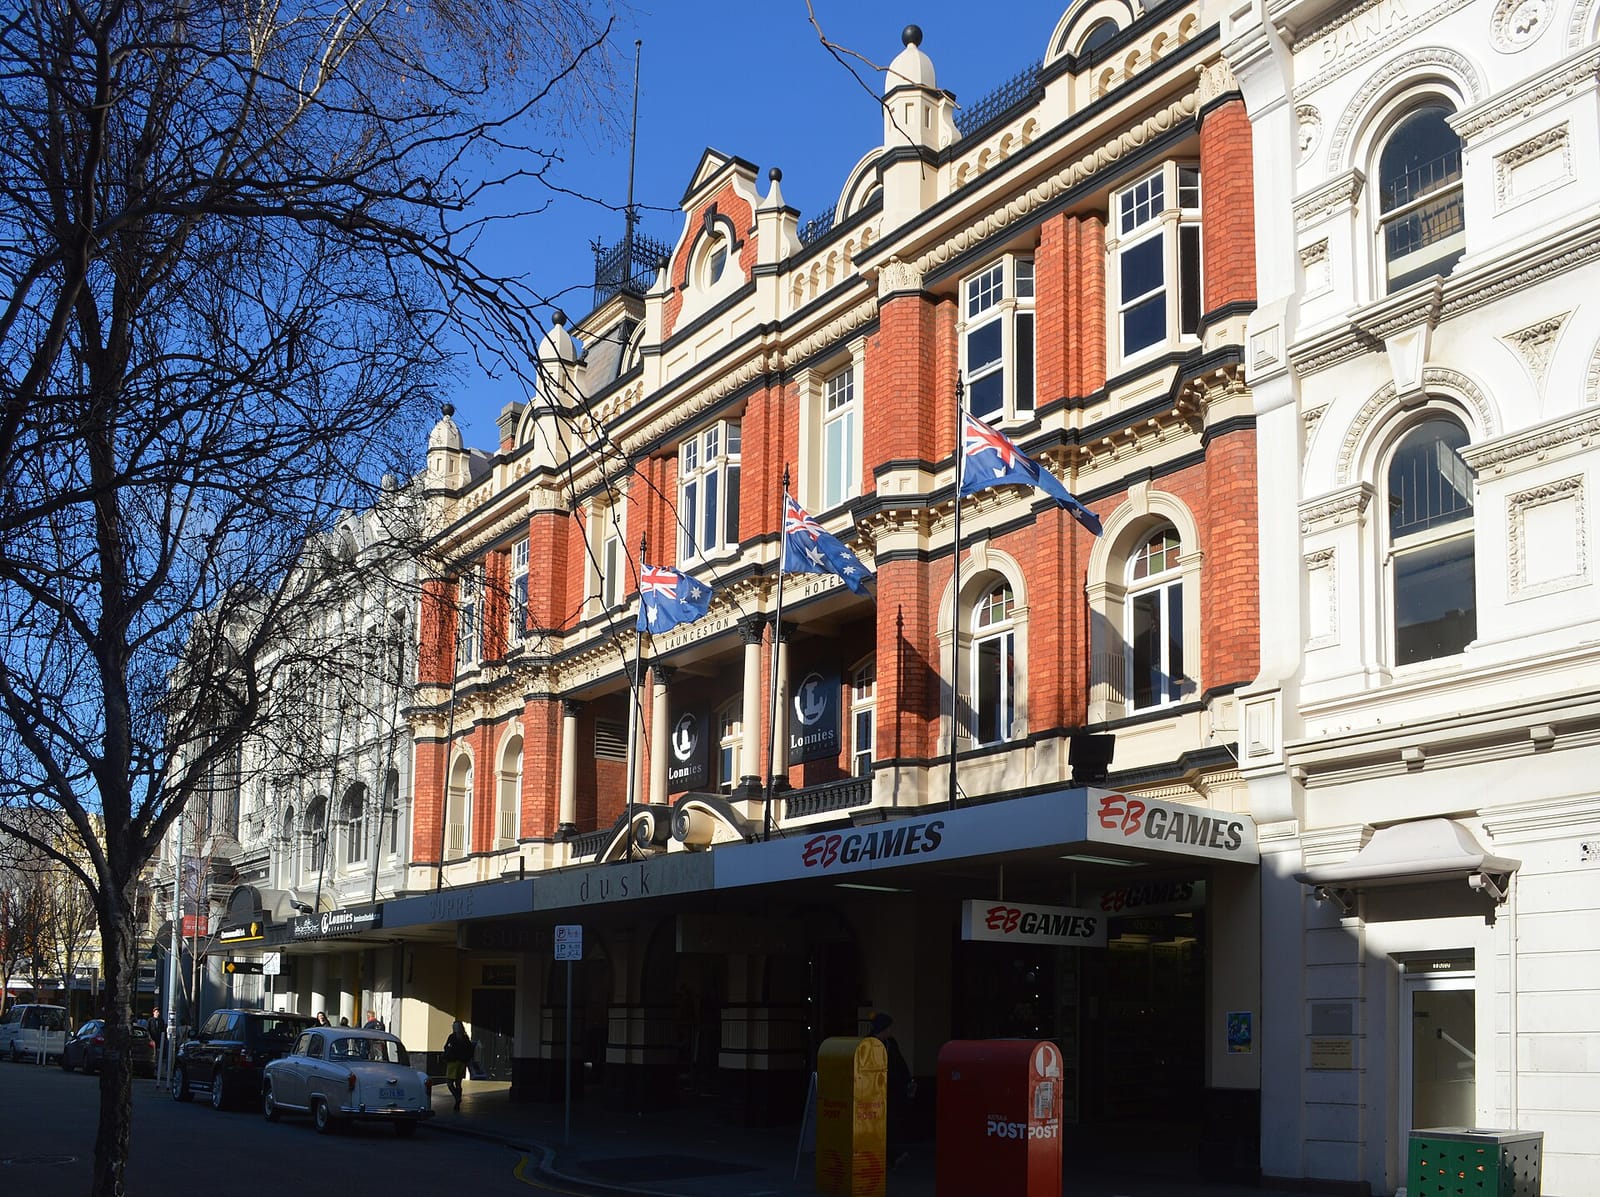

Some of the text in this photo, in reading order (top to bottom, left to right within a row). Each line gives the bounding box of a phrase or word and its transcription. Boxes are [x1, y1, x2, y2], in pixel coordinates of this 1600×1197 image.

[1318, 0, 1409, 69] BANK
[586, 576, 843, 681] THE LAUNCESTON HOTEL
[790, 729, 834, 749] Lonnies
[668, 763, 702, 780] Lonnies
[840, 821, 945, 864] GAMES
[1144, 808, 1244, 851] GAMES
[580, 864, 650, 902] dusk
[328, 910, 354, 925] Lonnies
[1019, 912, 1098, 938] GAMES
[987, 1120, 1027, 1139] POST
[1028, 1124, 1058, 1139] POST
